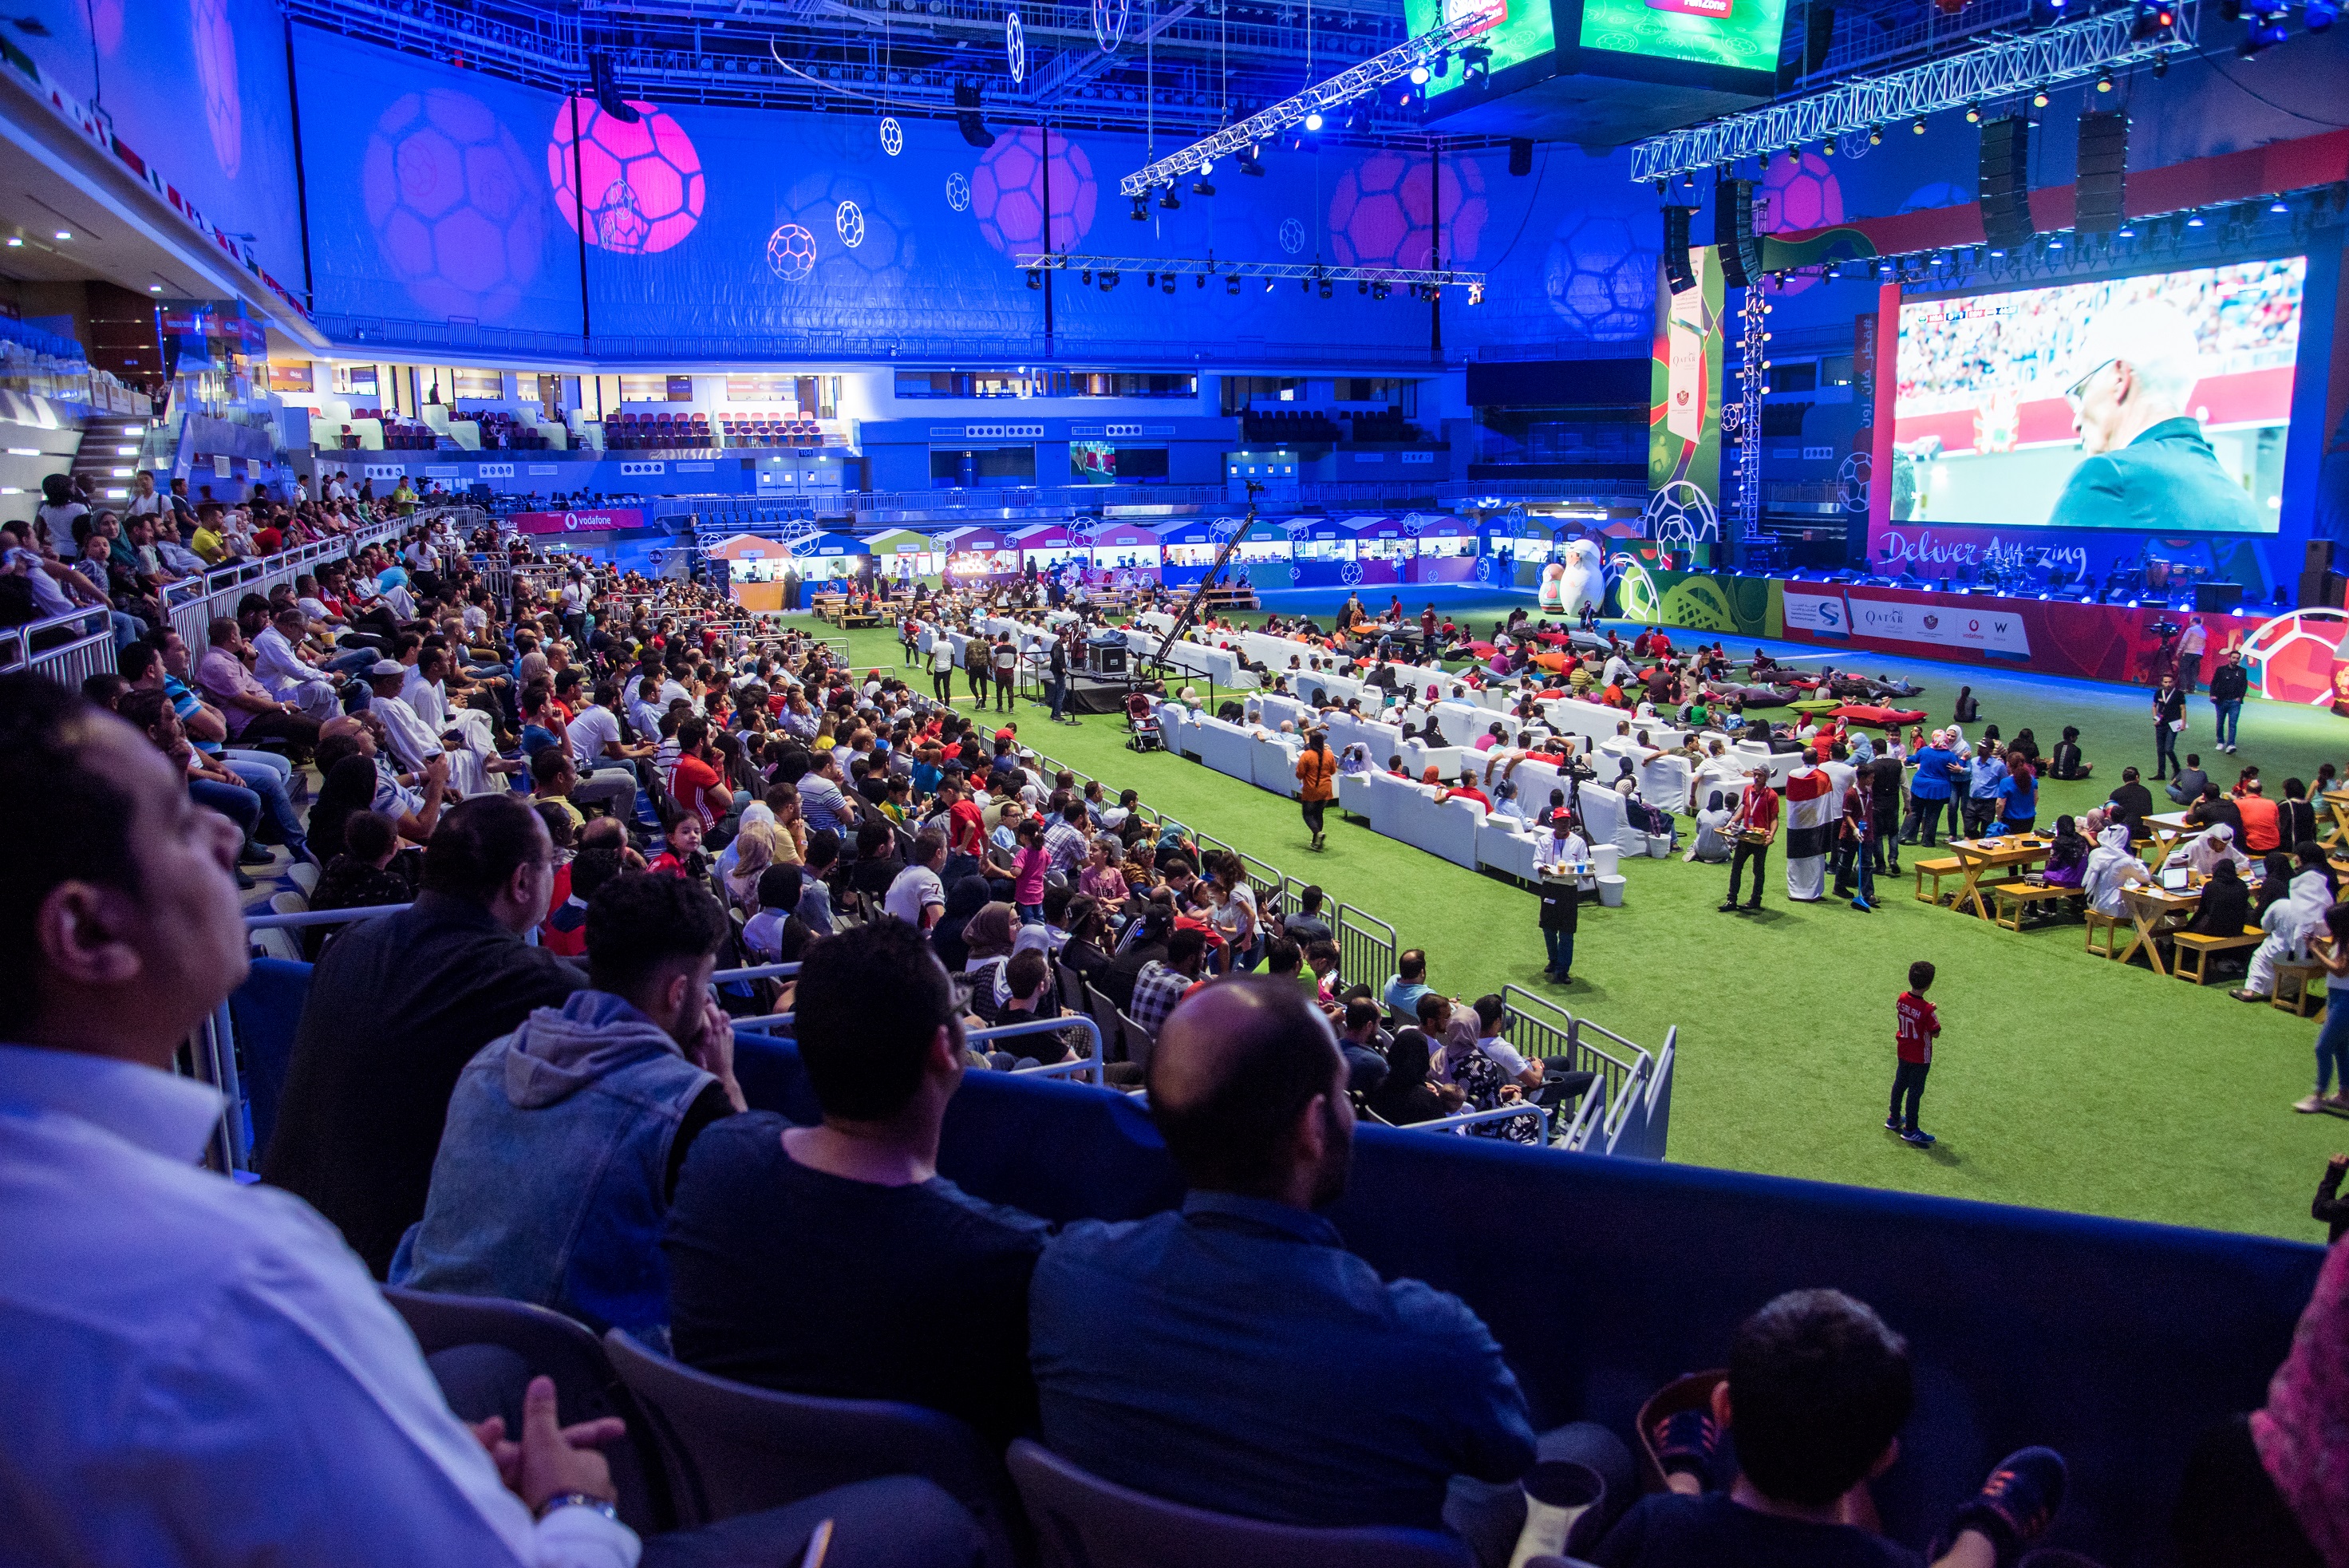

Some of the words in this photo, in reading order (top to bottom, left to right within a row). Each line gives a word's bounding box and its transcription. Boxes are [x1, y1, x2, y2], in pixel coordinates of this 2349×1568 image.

[578, 515, 611, 525] vodafone
[1877, 531, 1979, 566] Deliver
[1994, 622, 2008, 633] W
[931, 883, 940, 895] 7
